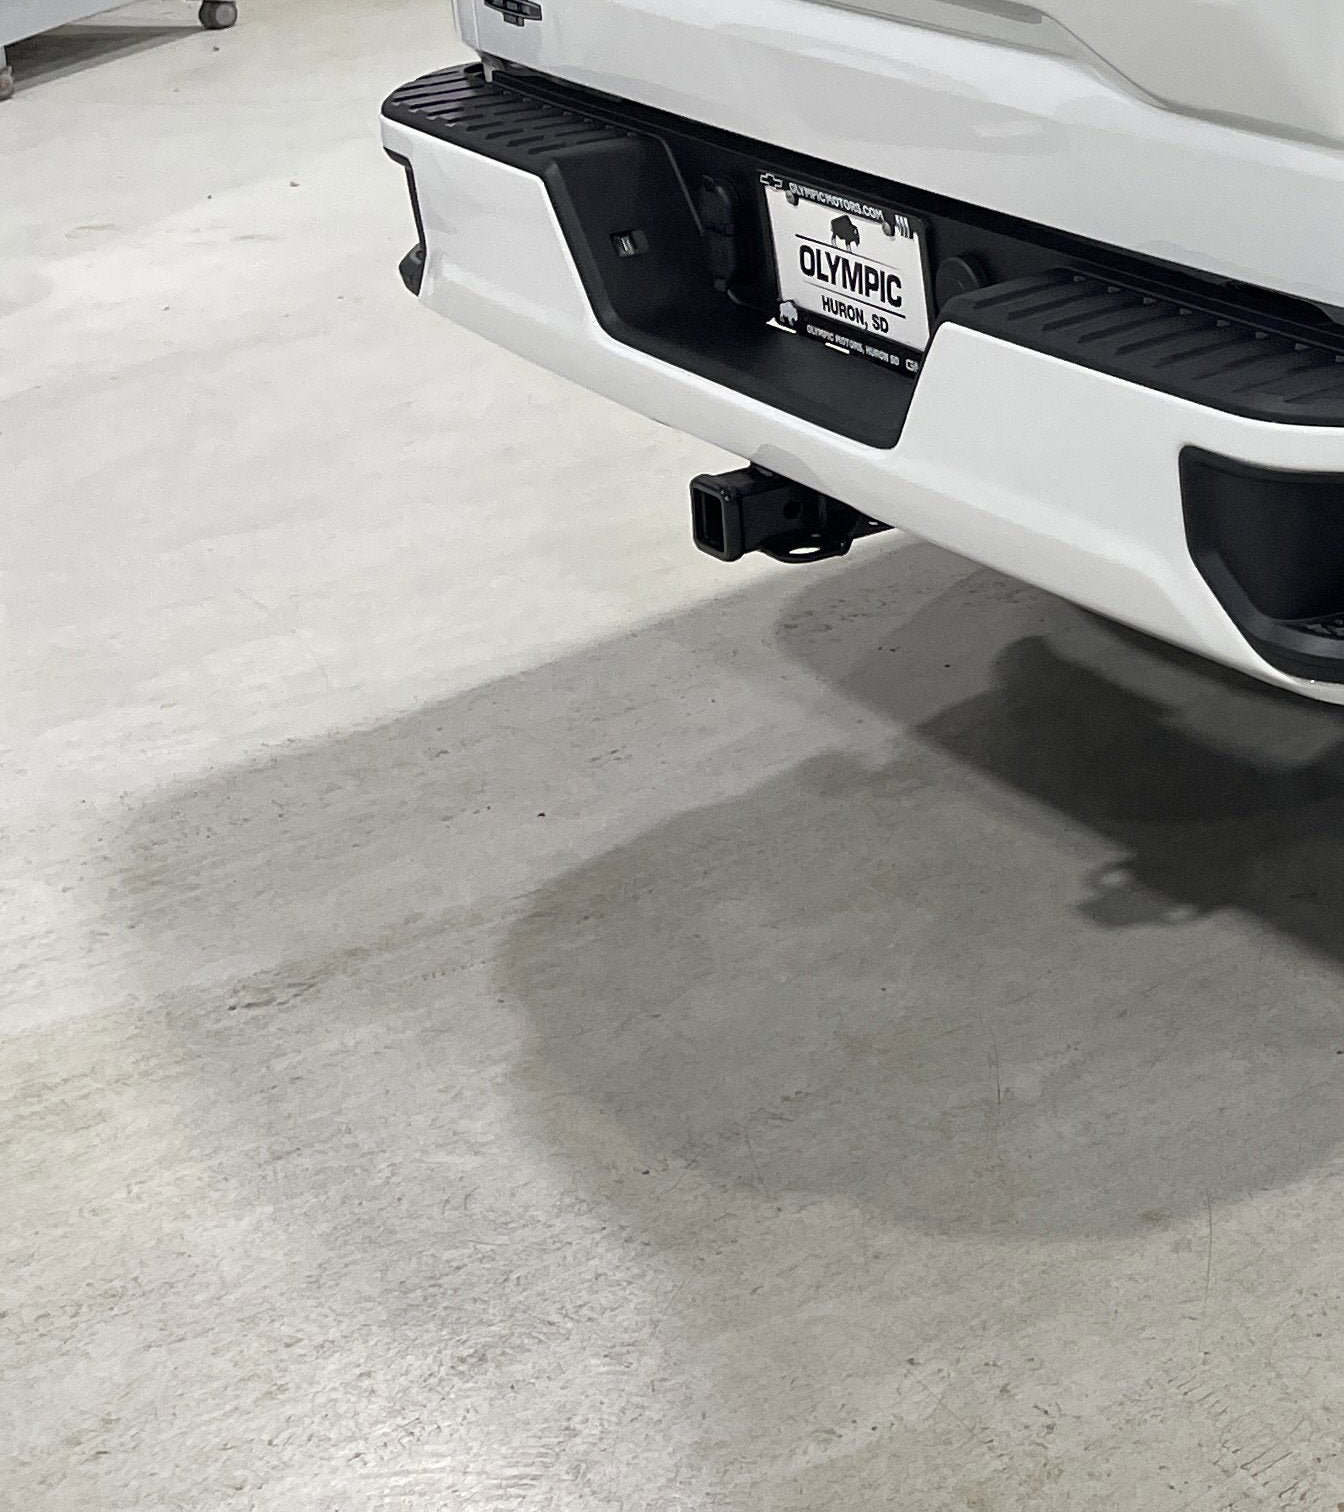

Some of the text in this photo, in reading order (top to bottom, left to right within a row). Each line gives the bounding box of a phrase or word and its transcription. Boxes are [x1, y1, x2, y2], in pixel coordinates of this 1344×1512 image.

[800, 245, 902, 307] OLYMPIC
[821, 295, 889, 334] HURON, SD
